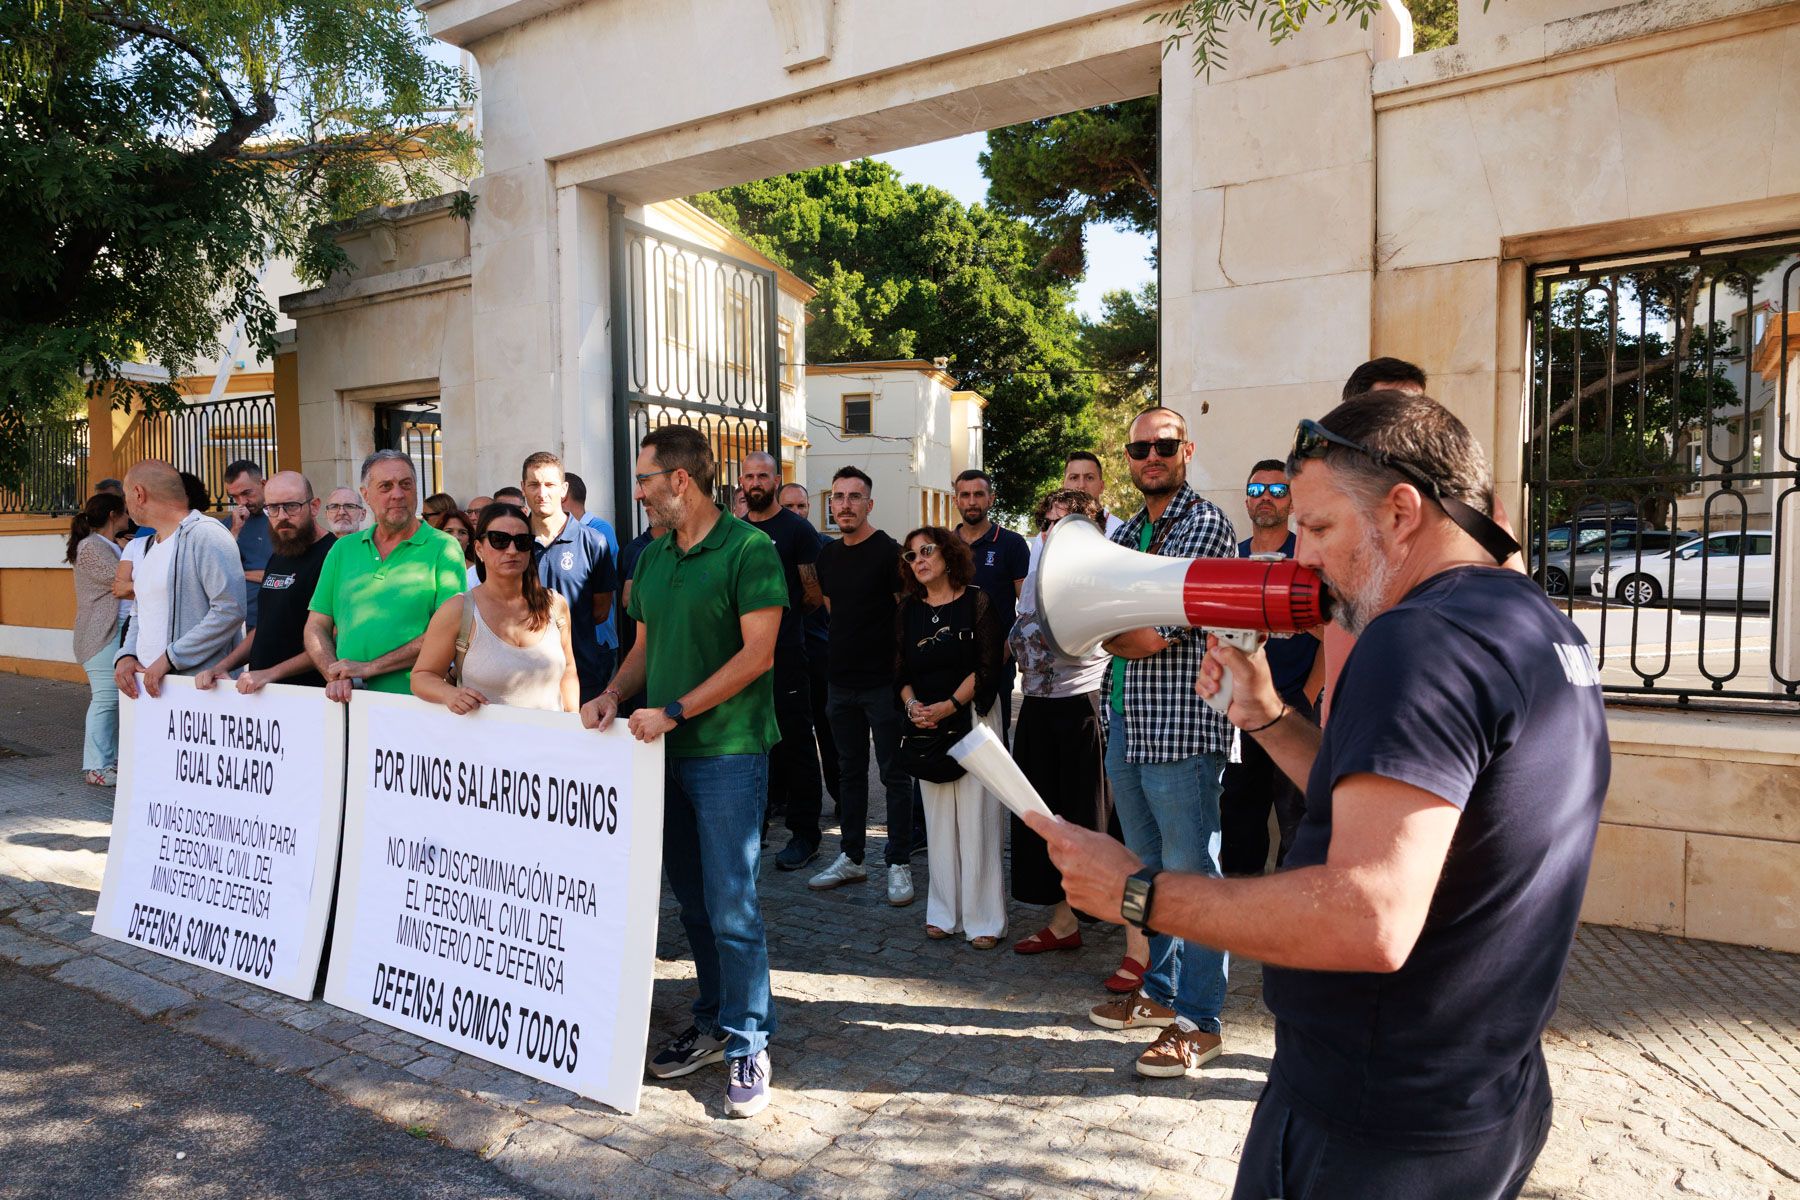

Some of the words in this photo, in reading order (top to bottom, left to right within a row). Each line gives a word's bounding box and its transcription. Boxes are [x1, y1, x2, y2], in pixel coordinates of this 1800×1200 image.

[168, 709, 176, 741] A
[179, 710, 216, 746] IGUAL
[220, 714, 285, 759] TRABAJO,
[175, 749, 212, 786] IGUAL
[216, 754, 274, 796] SALARIO
[374, 748, 405, 794] POR
[409, 753, 452, 803] UNOS
[457, 761, 541, 820] SALARIOS
[547, 776, 618, 836] DIGNOS
[147, 802, 162, 829] NO
[163, 800, 184, 833] MÁS
[185, 808, 268, 851] DISCRIMINACIÓN
[269, 823, 297, 856] PARA
[159, 835, 171, 862] EL
[172, 837, 224, 874] PERSONAL
[226, 849, 250, 881] CIVIL
[252, 854, 273, 885] DEL
[150, 864, 205, 903] MINISTERIO
[205, 878, 222, 907] DE
[221, 882, 271, 920] DEFENSA
[386, 836, 406, 869] NO
[408, 836, 437, 876] MÁS
[438, 847, 553, 906] DISCRIMINACIÓN
[556, 874, 598, 918] PARA
[405, 877, 421, 912] EL
[423, 882, 495, 933] PERSONAL
[498, 902, 533, 943] CIVIL
[536, 912, 566, 953] DEL
[127, 902, 183, 949] DEFENSA
[182, 917, 230, 967] SOMOS
[230, 929, 277, 980] TODOS
[396, 913, 472, 965] MINISTERIO
[473, 935, 495, 974] DE
[495, 942, 564, 996] DEFENSA
[372, 962, 446, 1028] DEFENSA
[448, 986, 512, 1050] SOMOS
[516, 1006, 581, 1075] TODOS
